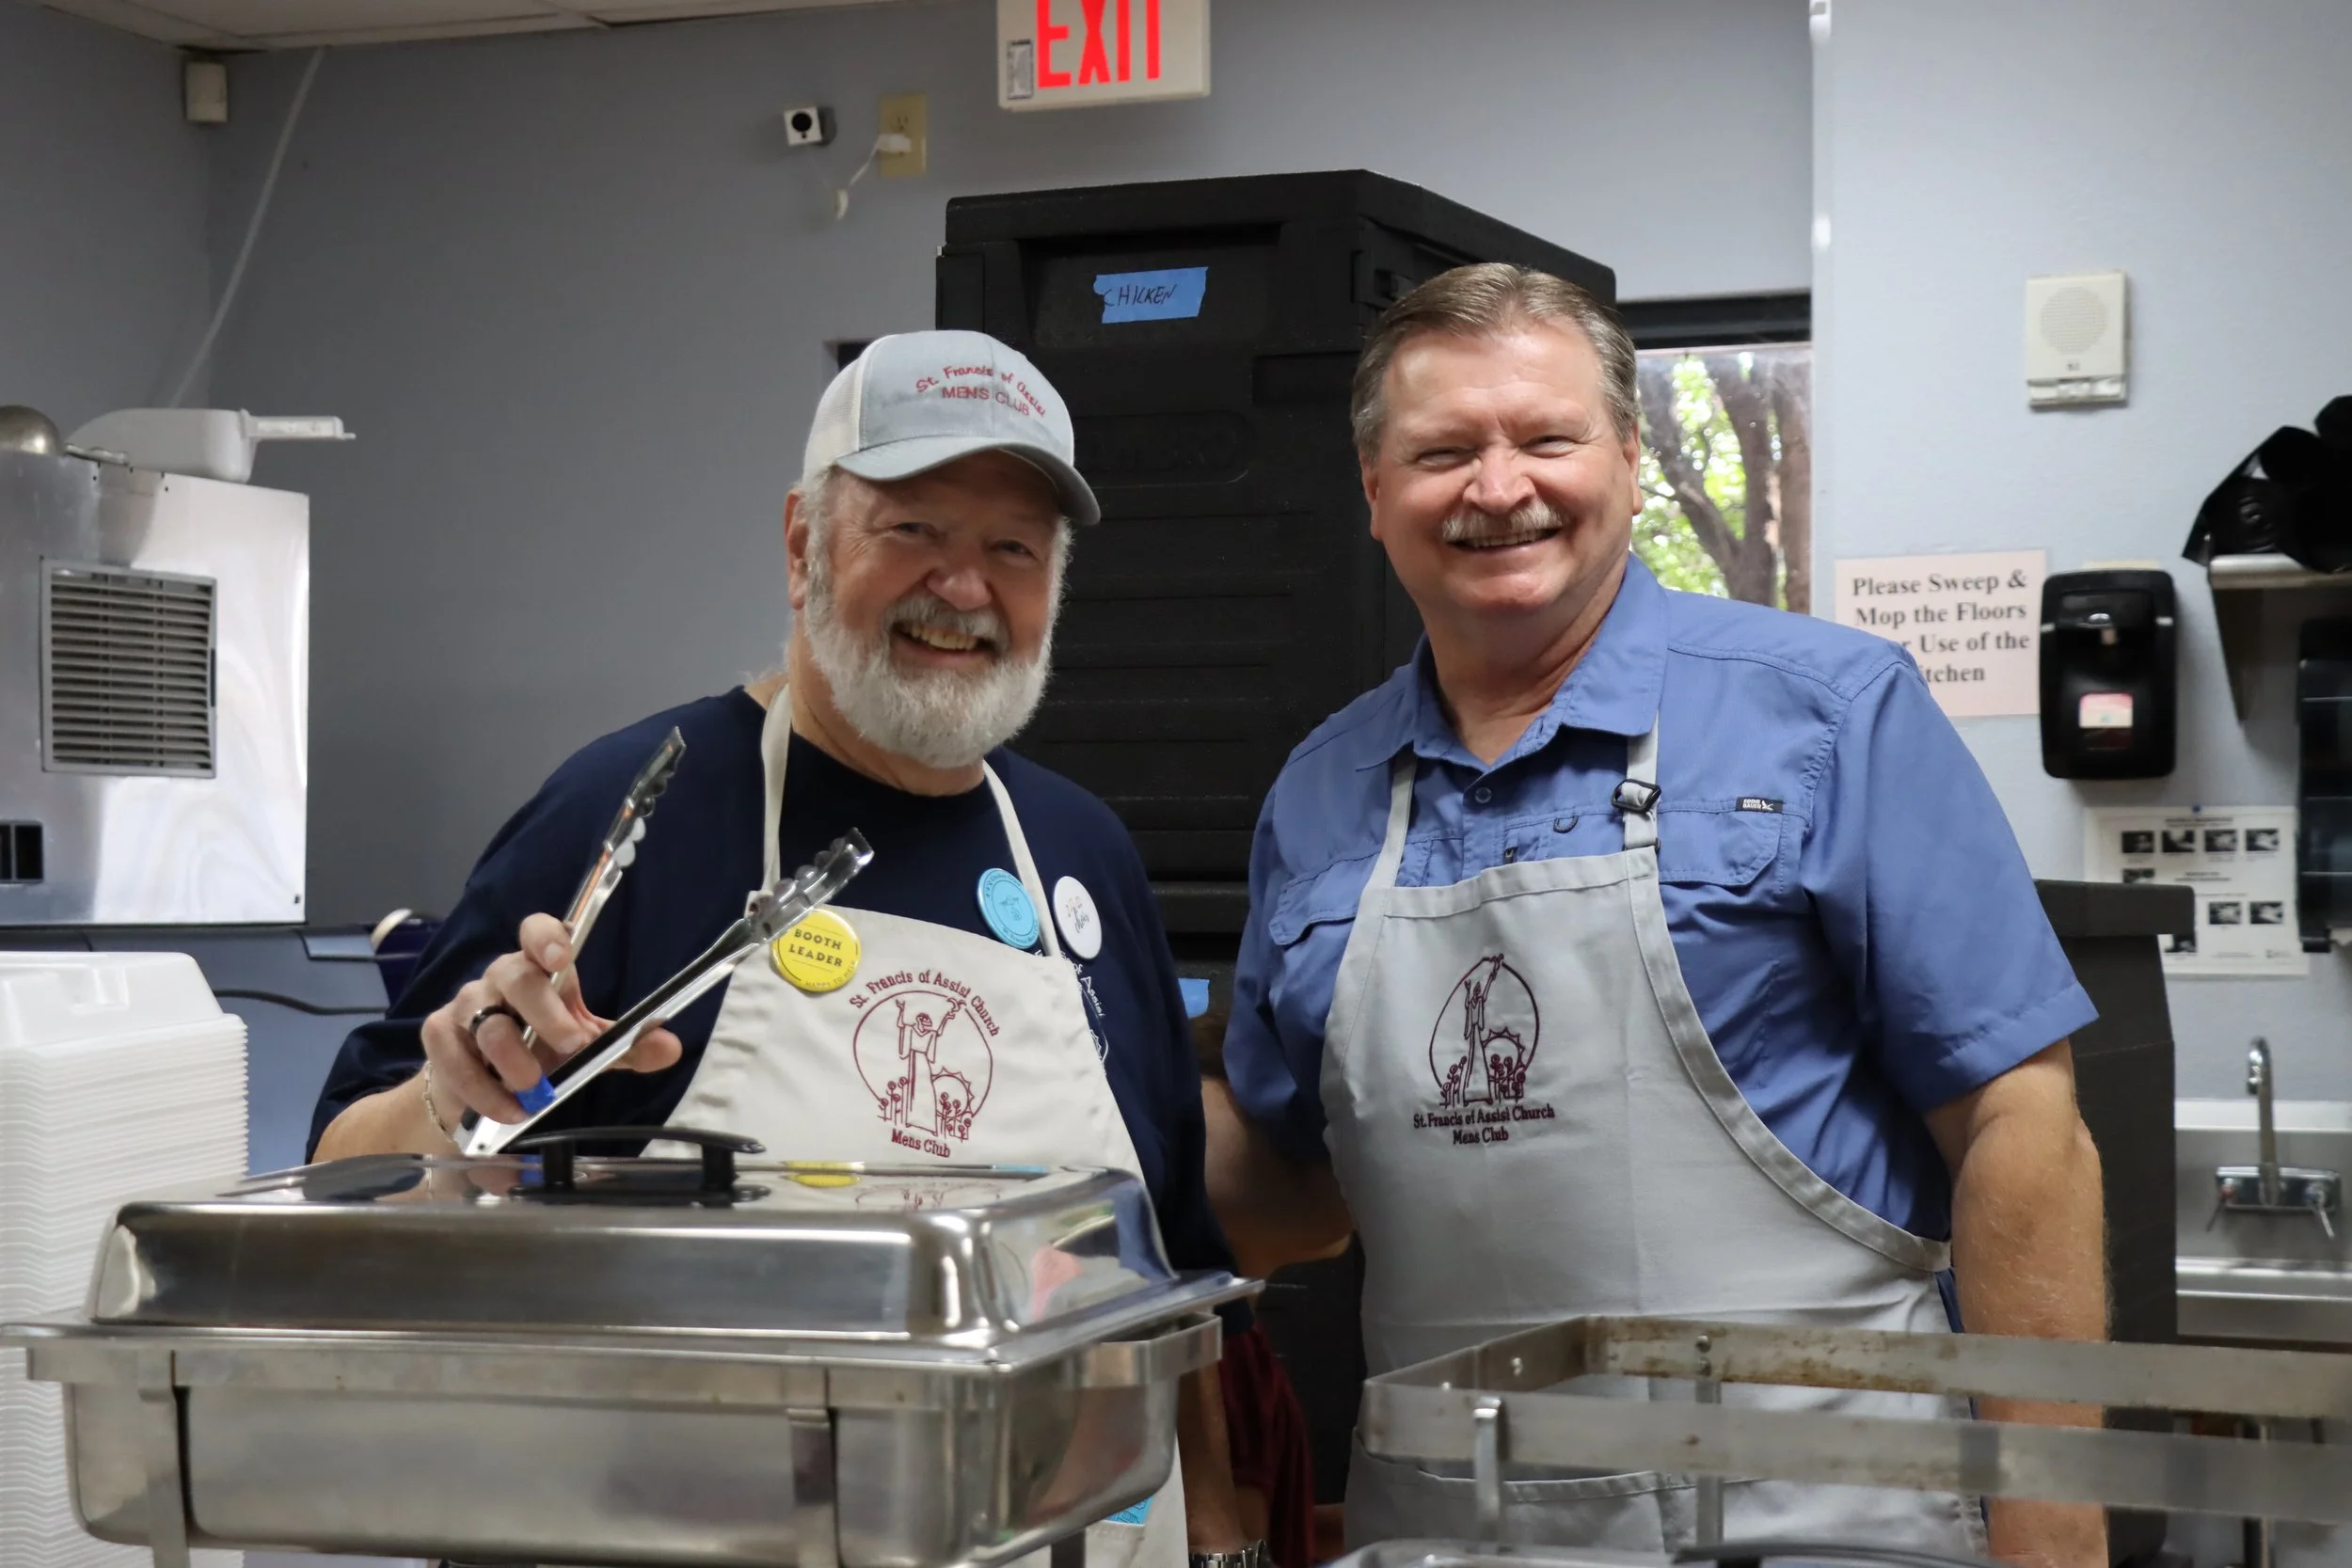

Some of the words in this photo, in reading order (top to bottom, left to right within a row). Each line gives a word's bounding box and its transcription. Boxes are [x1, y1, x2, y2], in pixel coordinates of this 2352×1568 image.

[1037, 0, 1161, 89] EXIT
[1104, 283, 1178, 307] CHICKEN
[942, 387, 991, 400] MENS
[994, 391, 1030, 417] CLUB
[1852, 577, 1921, 596] Please
[1929, 573, 1999, 594] Sweep
[2008, 569, 2027, 588] &
[1855, 607, 1906, 629] Mop
[1915, 605, 1948, 623] the
[1957, 601, 2027, 622] Floors
[1920, 634, 1960, 654] Use
[1966, 631, 1989, 651] of
[1995, 630, 2030, 649] the
[1920, 664, 1986, 683] tchen
[794, 928, 842, 950] BOOTH
[788, 943, 843, 967] LEADER
[850, 993, 869, 1008] St.
[866, 971, 913, 994] Francis
[918, 970, 930, 983] of
[935, 972, 971, 998] Assisi
[971, 995, 1000, 1037] Church
[1080, 975, 1105, 1016] Assisi
[1413, 1114, 1427, 1128] St.
[1428, 1111, 1463, 1127] Francis
[1465, 1109, 1476, 1124] of
[1477, 1107, 1510, 1123] Assisi
[1512, 1103, 1554, 1120] Church
[891, 1129, 921, 1149] Mens
[923, 1138, 950, 1158] Club
[1453, 1130, 1480, 1145] Mens
[1482, 1126, 1509, 1143] Club
